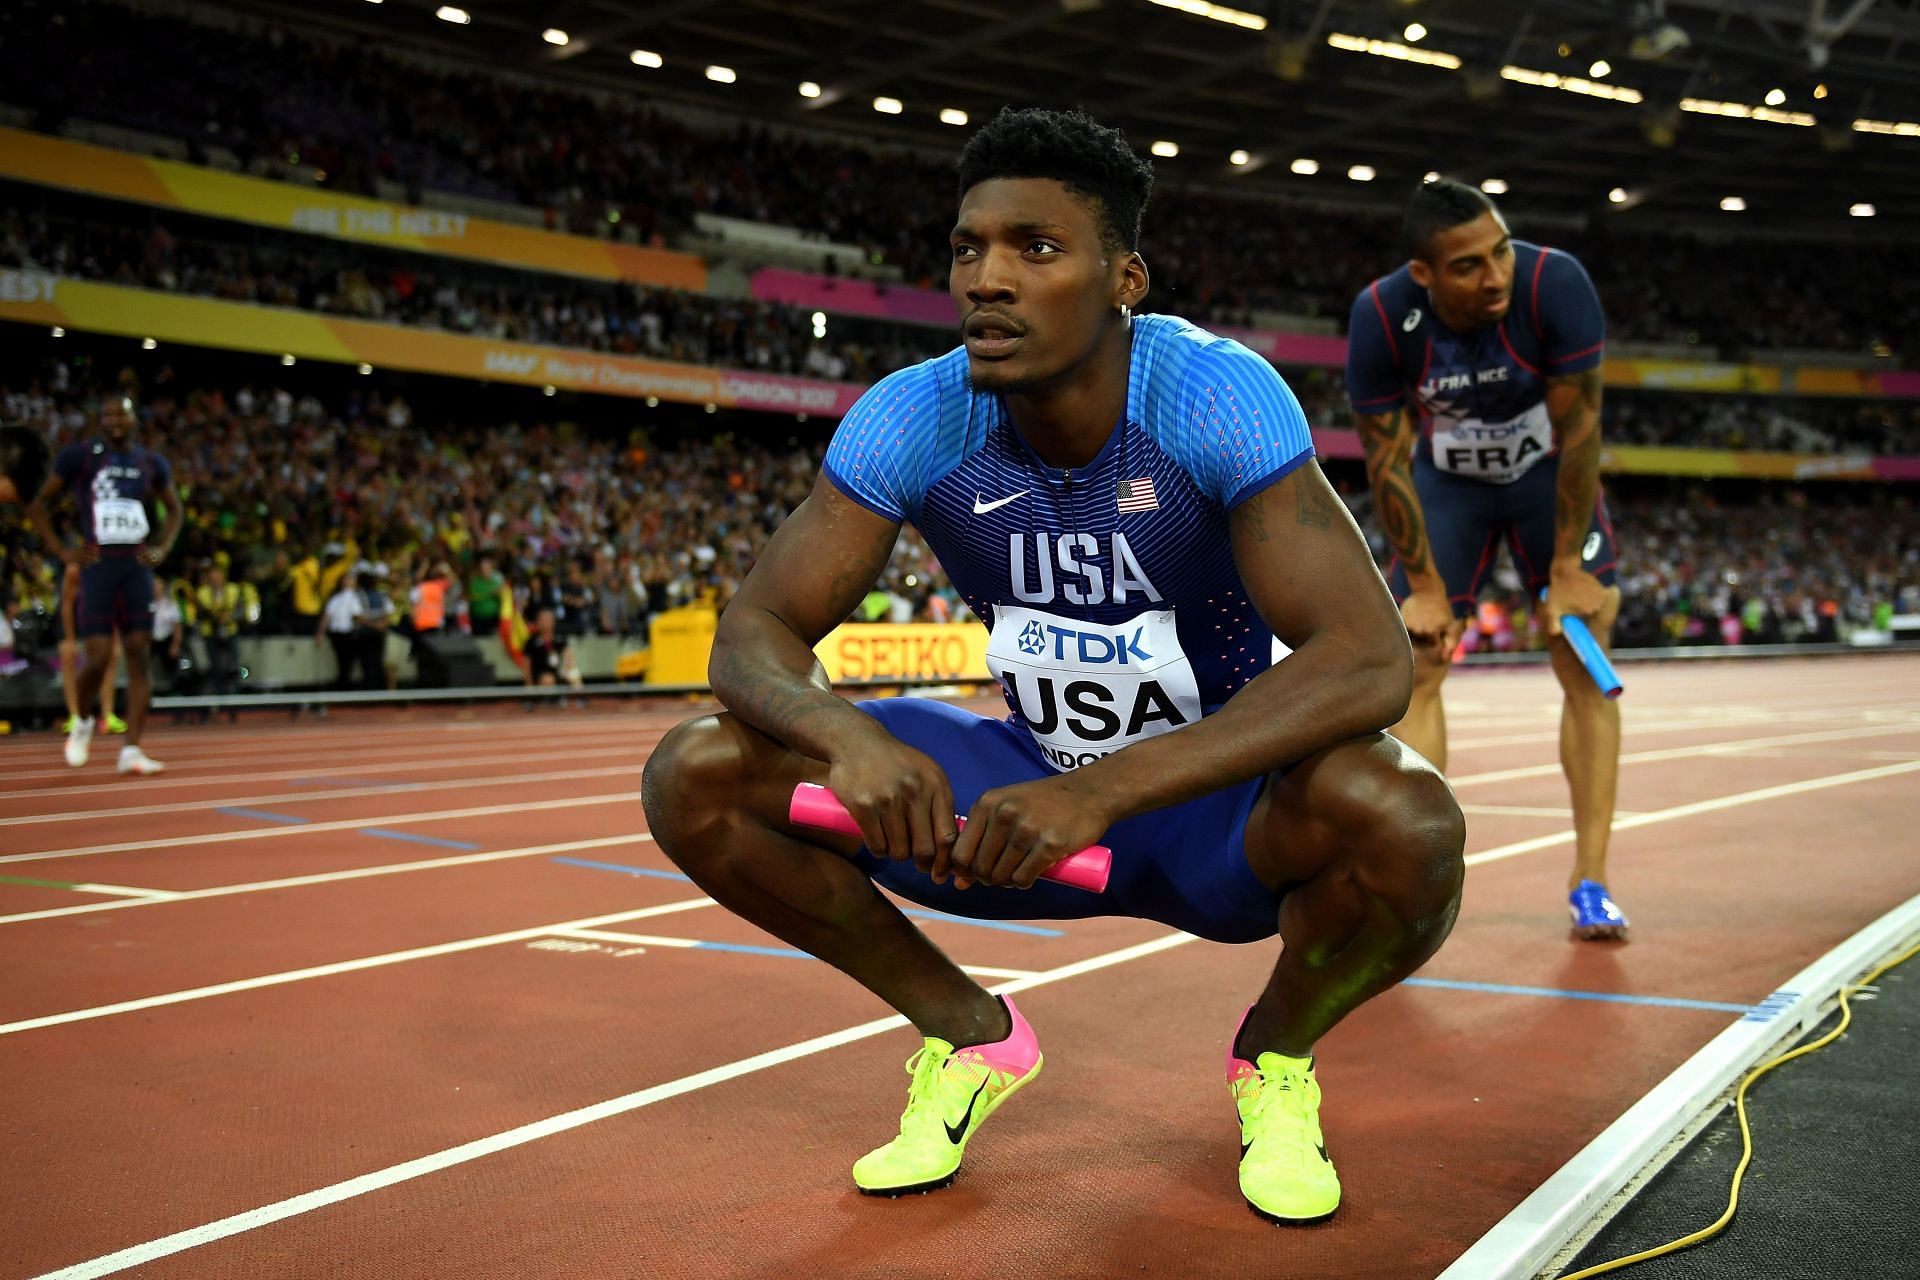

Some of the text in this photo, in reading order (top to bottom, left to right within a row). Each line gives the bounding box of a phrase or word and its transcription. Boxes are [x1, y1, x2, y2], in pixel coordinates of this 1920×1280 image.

[1446, 435, 1542, 470] FRA
[1010, 532, 1164, 604] USA
[838, 635, 969, 681] SEIKO
[1047, 625, 1154, 665] TDK
[1002, 671, 1188, 741] USA
